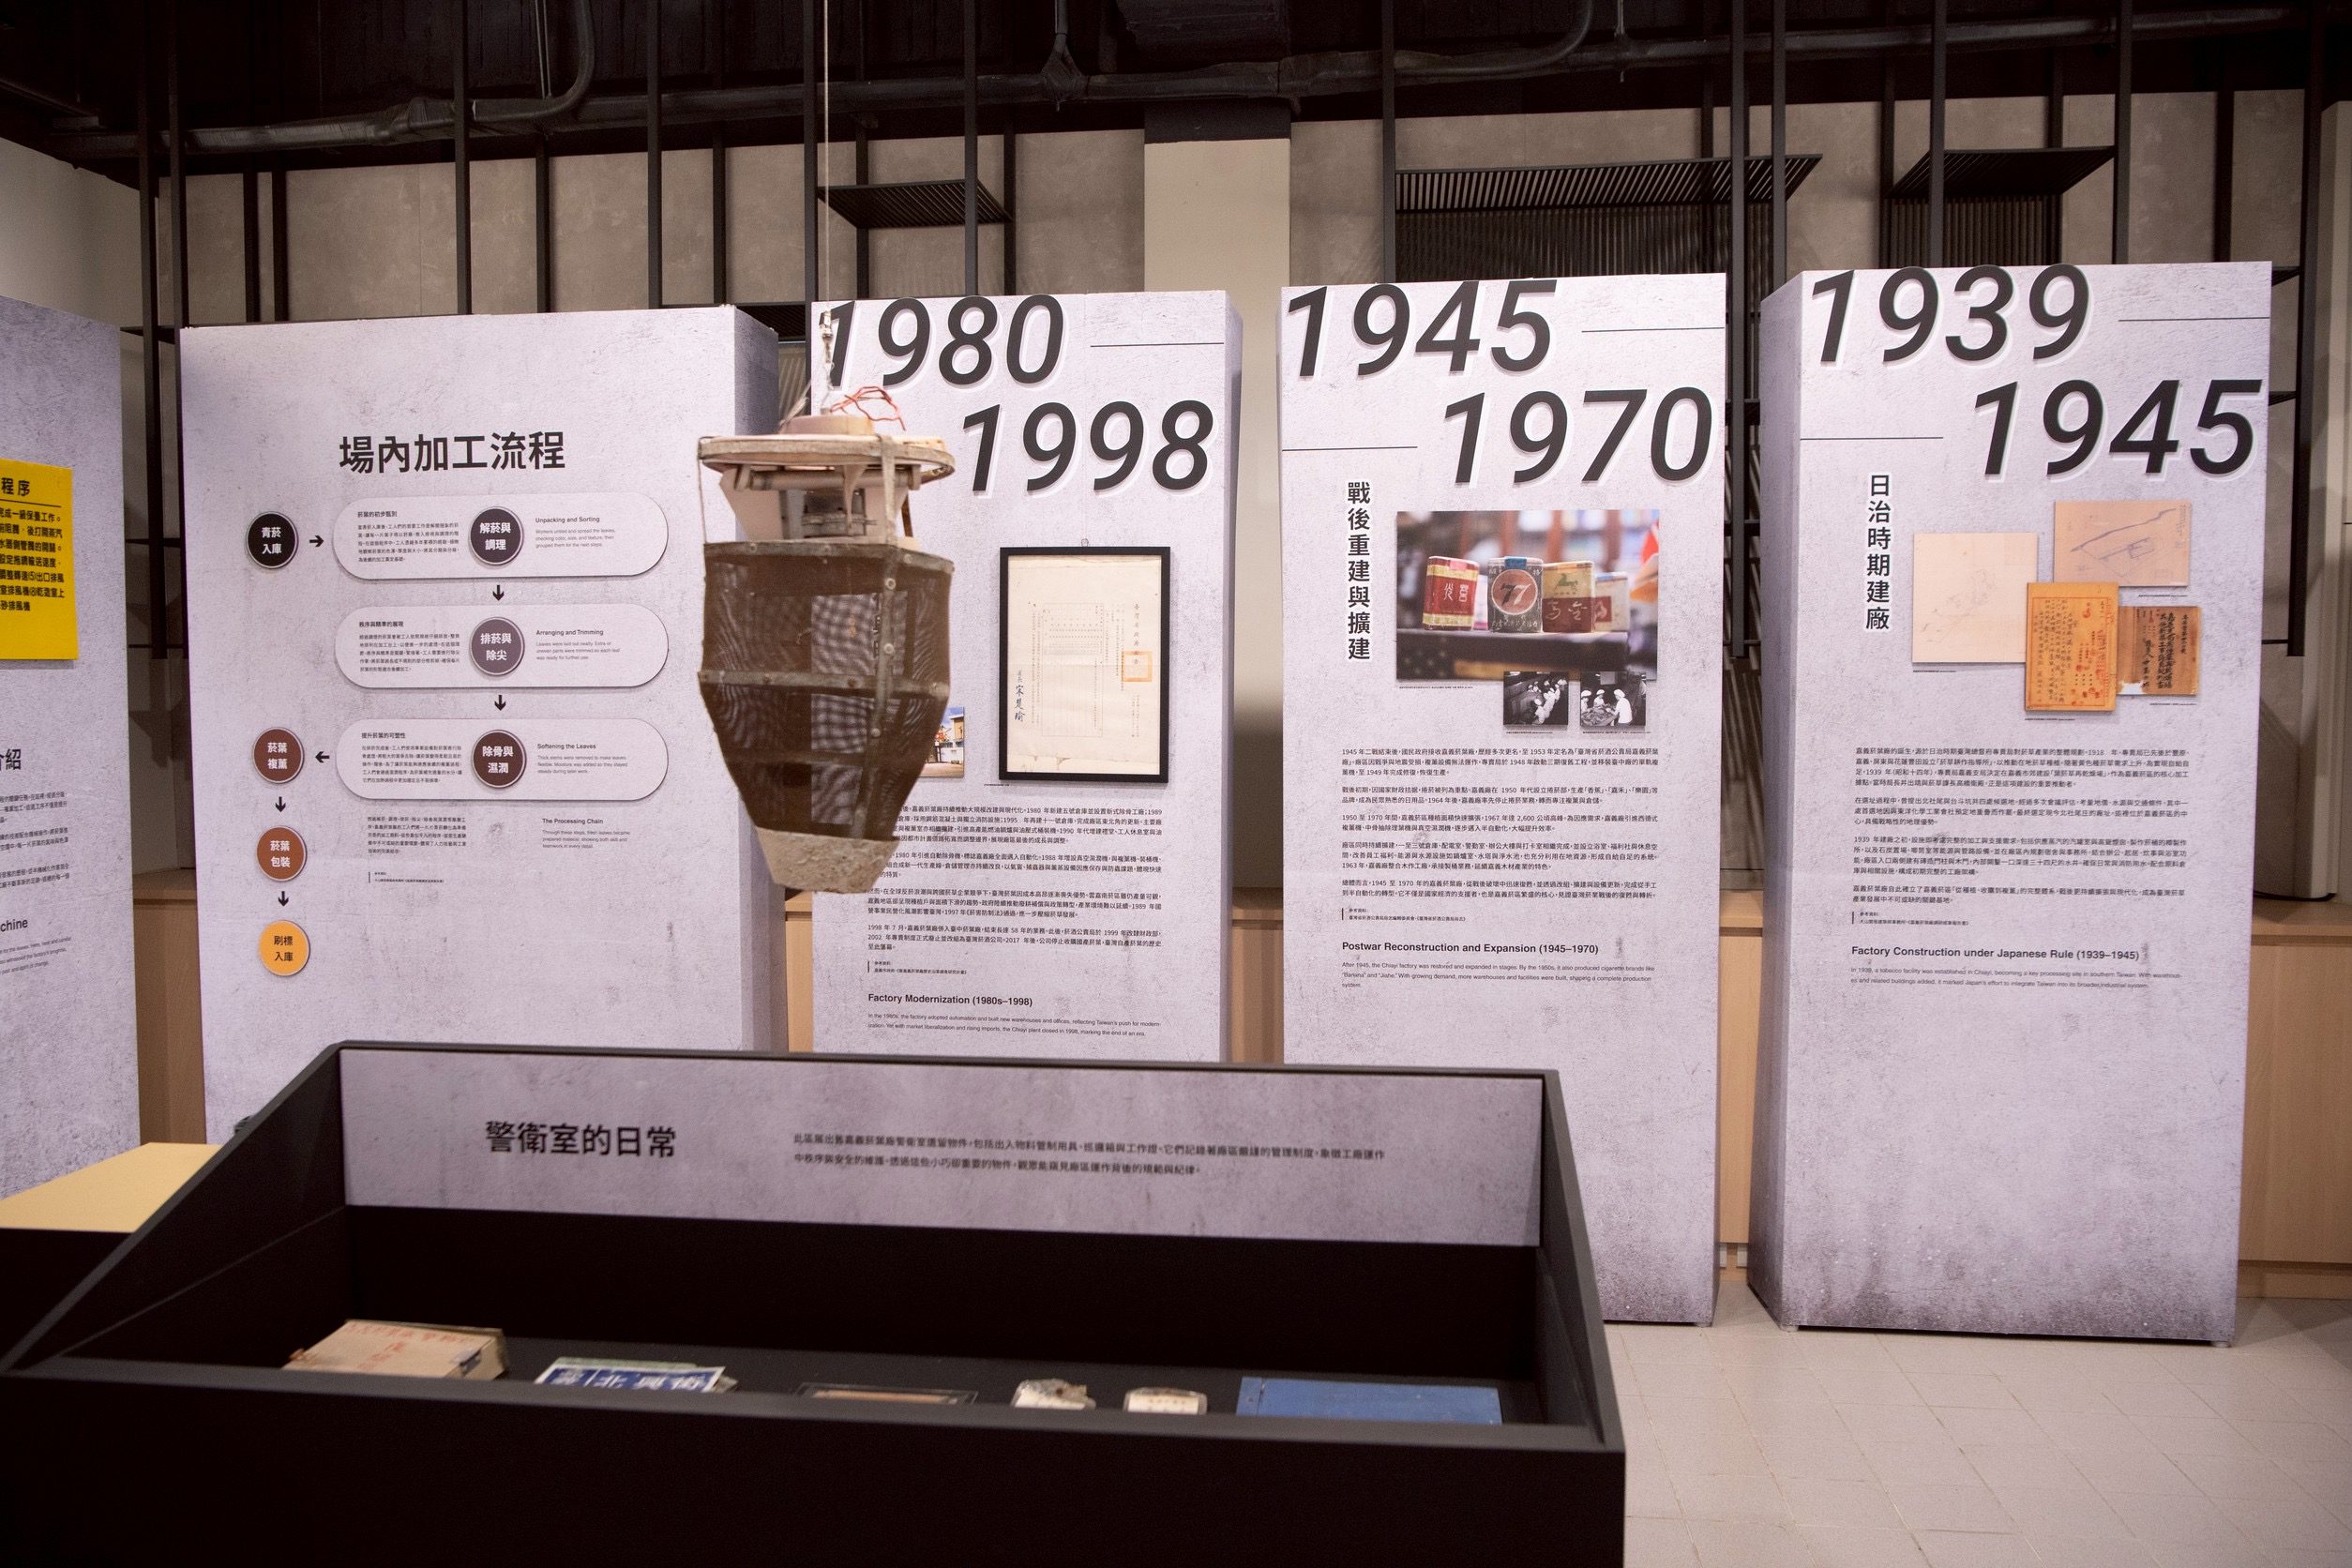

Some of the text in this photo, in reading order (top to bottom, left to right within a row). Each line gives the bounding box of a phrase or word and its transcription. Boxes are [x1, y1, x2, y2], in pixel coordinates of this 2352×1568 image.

[1289, 279, 1557, 378] 1945
[1812, 264, 2088, 363] 1939
[819, 294, 1063, 387] 1980
[962, 400, 1214, 492] 1998
[1444, 386, 1711, 484] 1970
[1974, 379, 2262, 476] 1945
[339, 430, 566, 475] 場內加工流程
[1, 477, 30, 496] 程序
[263, 543, 282, 555] 入庫
[1866, 475, 1892, 630] 日治時期建廠
[1348, 481, 1371, 660] 戰後重建與擴建
[1500, 582, 1531, 606] 77
[486, 649, 507, 662] 除尖
[275, 951, 294, 963] 入庫
[1342, 942, 1599, 955] Postwar Reconstruction and Expansion (1945–1970)
[1851, 946, 2139, 961] Factory Construction under Japanese Rule (1939–1945)
[868, 994, 1033, 1006] Factory Modernization (1980s–1998)
[486, 1121, 676, 1157] 警衛室的日常
